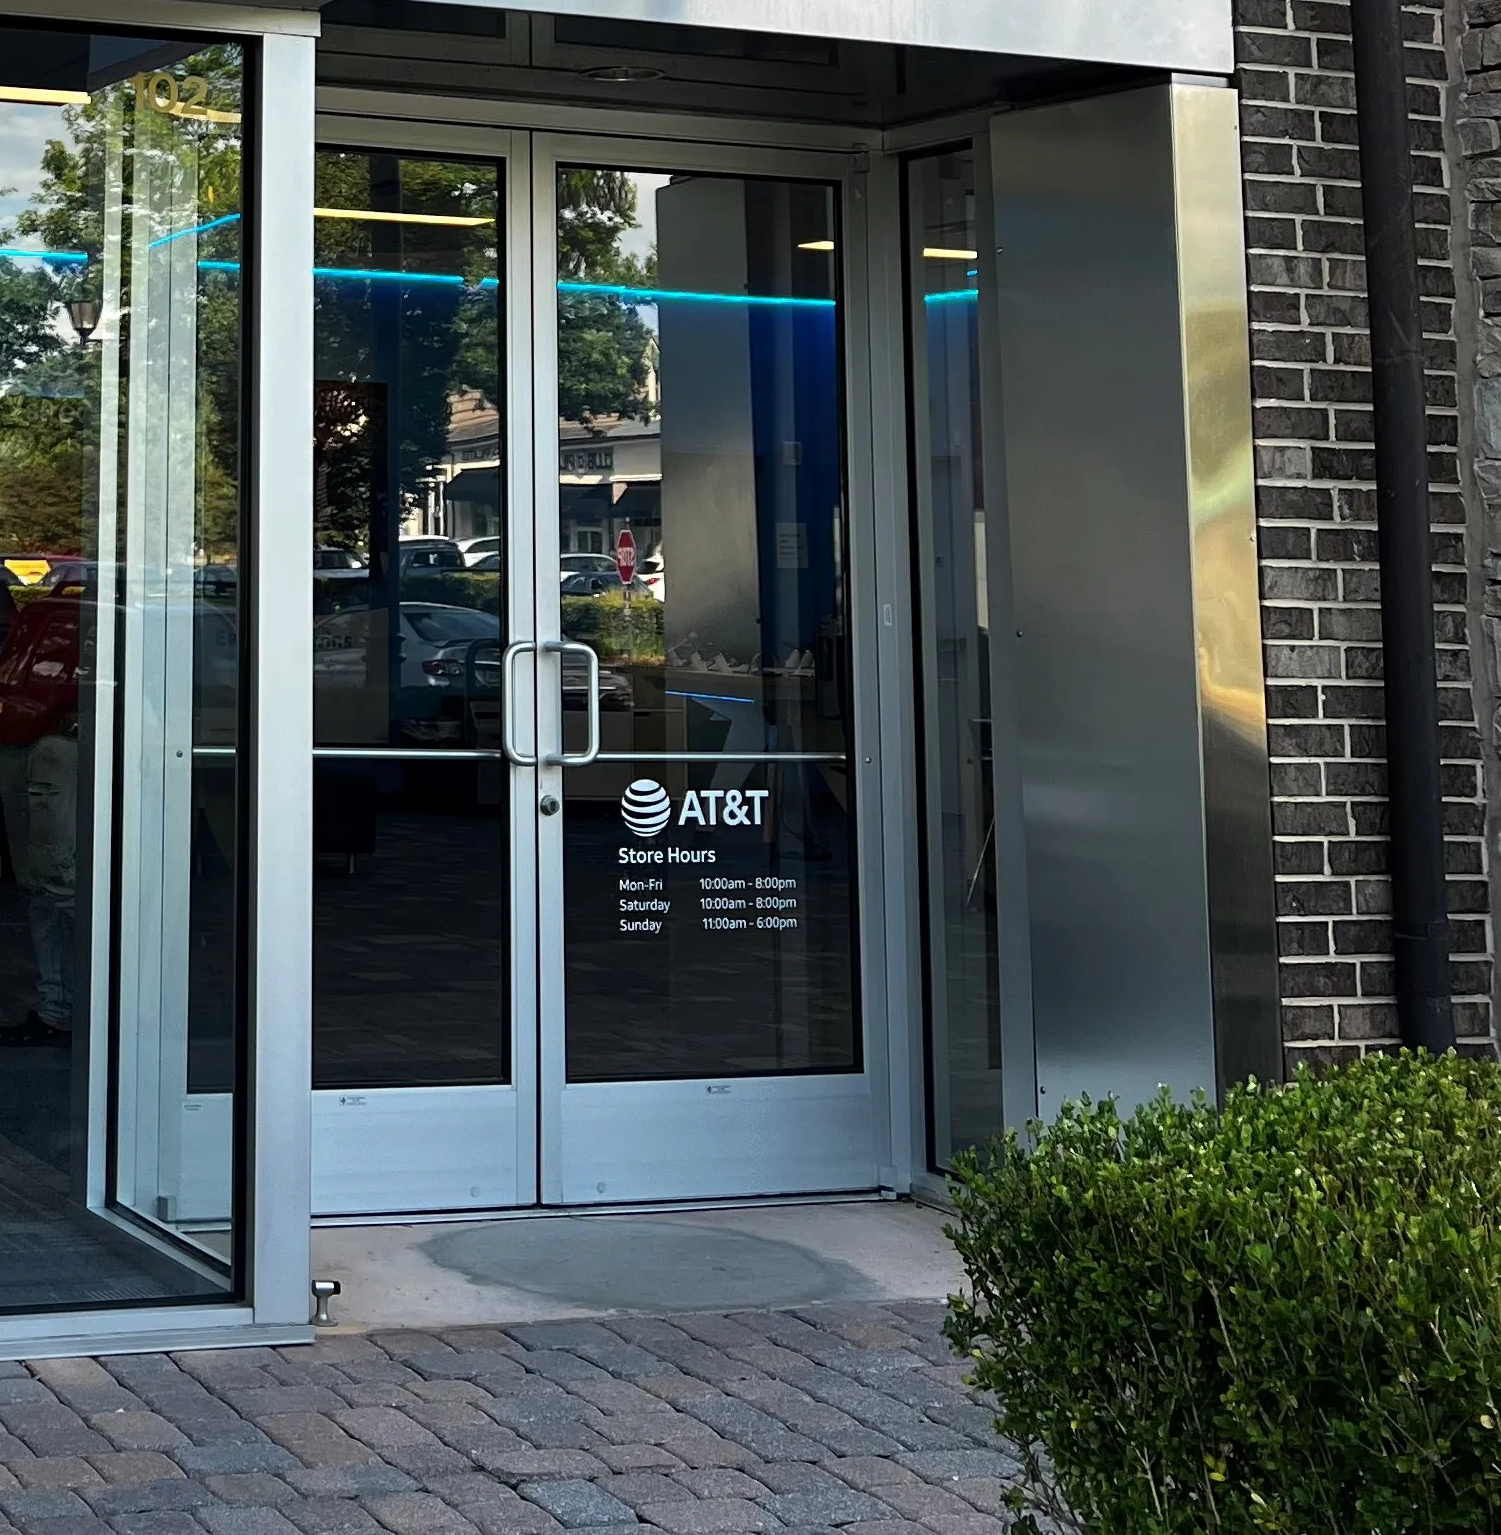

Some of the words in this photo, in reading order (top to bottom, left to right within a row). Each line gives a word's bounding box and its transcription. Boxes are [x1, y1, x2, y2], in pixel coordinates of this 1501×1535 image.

[130, 72, 208, 115] 102
[678, 789, 769, 826] AT&T
[618, 847, 664, 864] Store
[668, 847, 716, 863] Hours
[619, 878, 663, 891] Mon-Fri
[699, 877, 746, 890] 10:00am
[755, 877, 797, 892] 8:00pm
[619, 899, 671, 913] Saturday
[699, 898, 746, 910] 10:00am
[755, 897, 797, 911] 8:00pm
[619, 919, 662, 934] Sunday
[702, 918, 747, 930] 11:00am
[756, 917, 798, 931] 6:00pm
